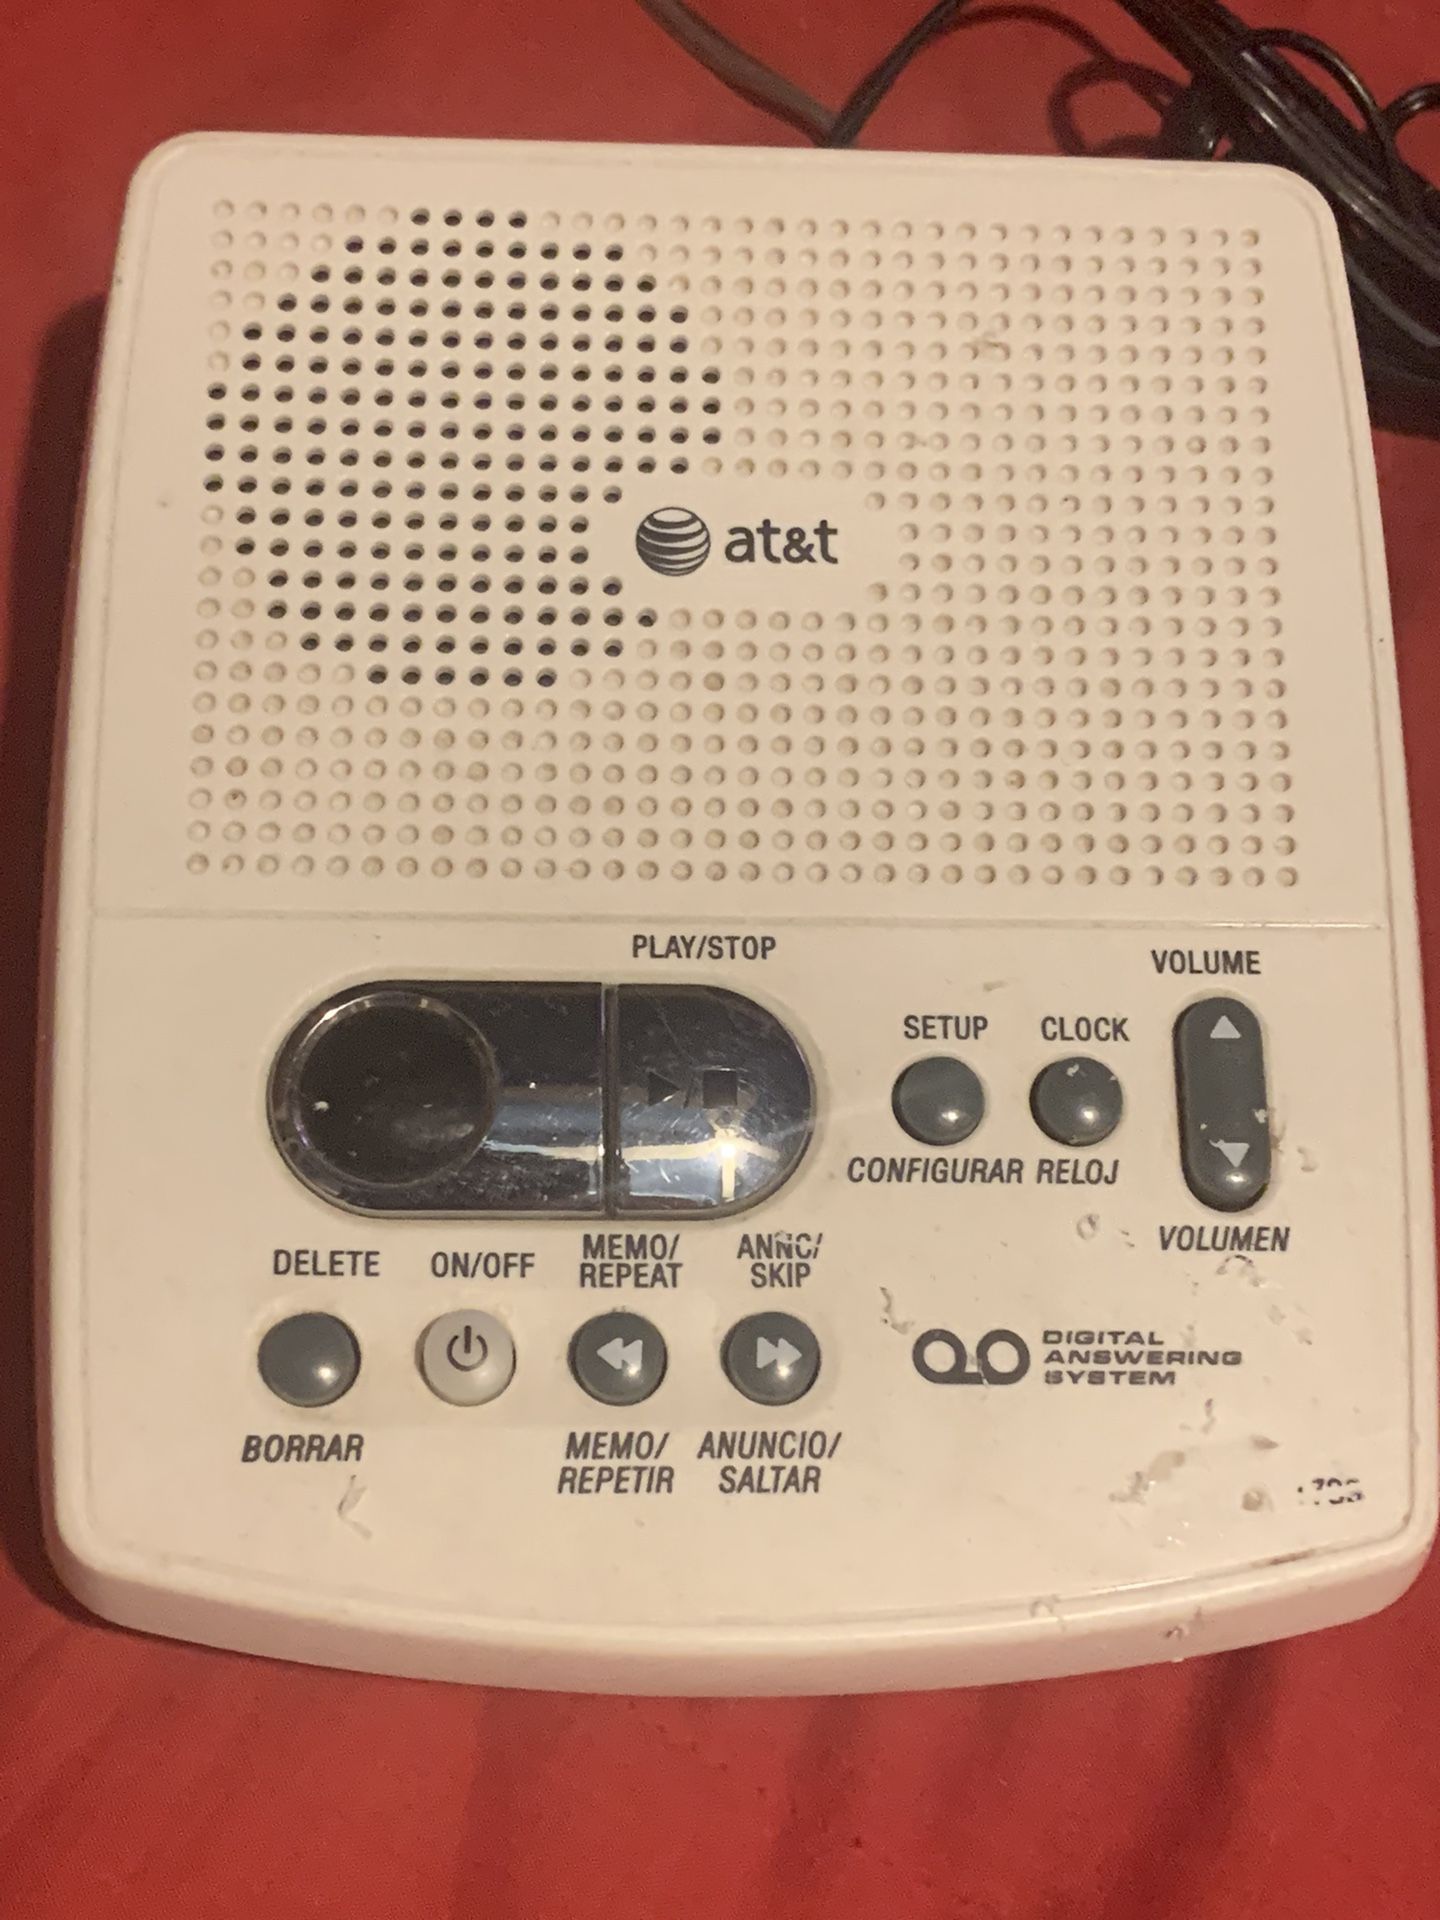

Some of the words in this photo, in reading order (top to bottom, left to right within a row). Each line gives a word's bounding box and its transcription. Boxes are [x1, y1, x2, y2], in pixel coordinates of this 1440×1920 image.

[724, 518, 839, 565] at&t
[632, 935, 777, 960] PLAY/STOP
[1151, 949, 1262, 975] VOLUME
[903, 1015, 988, 1040] SETUP
[1040, 1017, 1130, 1042] CLOCK
[847, 1156, 1024, 1184] CONFIGURAR
[1036, 1159, 1120, 1186] RELOJ
[581, 1233, 680, 1260] MEMO/
[737, 1232, 823, 1260] ANNC/
[1159, 1226, 1291, 1252] VOLUMEN
[273, 1250, 381, 1277] DELETE
[430, 1251, 536, 1279] ON/OFF
[580, 1262, 683, 1289] REPEAT
[750, 1262, 812, 1288] SKIP
[1042, 1330, 1165, 1346] DIGITAL
[1043, 1350, 1243, 1366] ANSWERING
[1044, 1370, 1176, 1386] SYSTEM
[241, 1433, 365, 1463] BORRAR
[565, 1432, 670, 1461] MEMO/
[697, 1430, 842, 1460] ANUNCIO/
[557, 1465, 675, 1495] REPETIR
[718, 1465, 821, 1494] SALTAR
